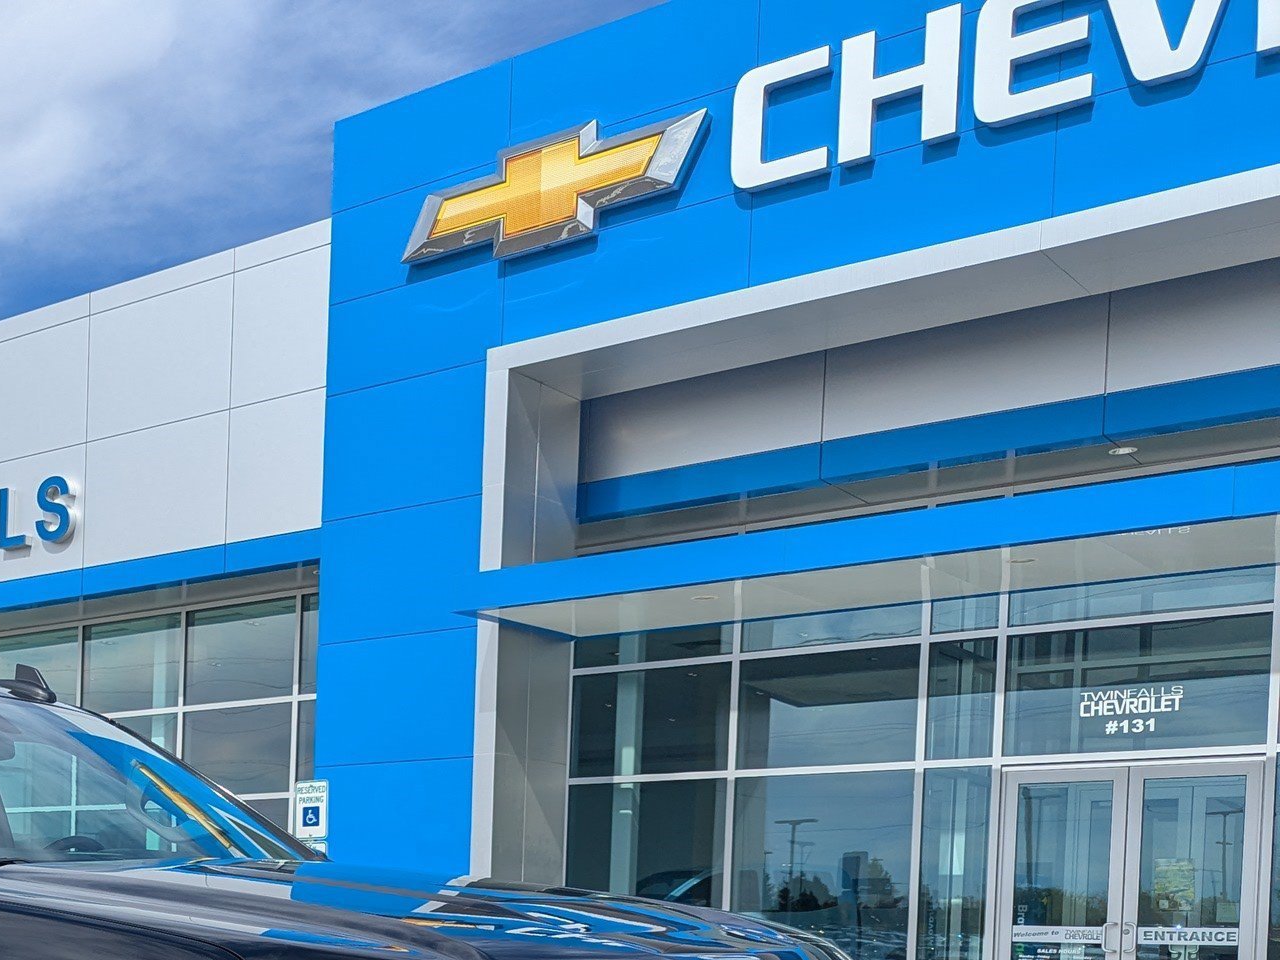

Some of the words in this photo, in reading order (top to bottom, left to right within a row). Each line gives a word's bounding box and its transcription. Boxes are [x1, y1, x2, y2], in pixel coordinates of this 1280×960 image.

[731, 0, 1280, 192] CHEV
[1080, 695, 1184, 717] CHEVROLET
[1105, 718, 1155, 735] #131
[298, 785, 326, 794] RESERVED
[298, 795, 324, 804] PARKING
[1013, 930, 1049, 938] Welcome
[1143, 930, 1237, 942] ENTRANCE
